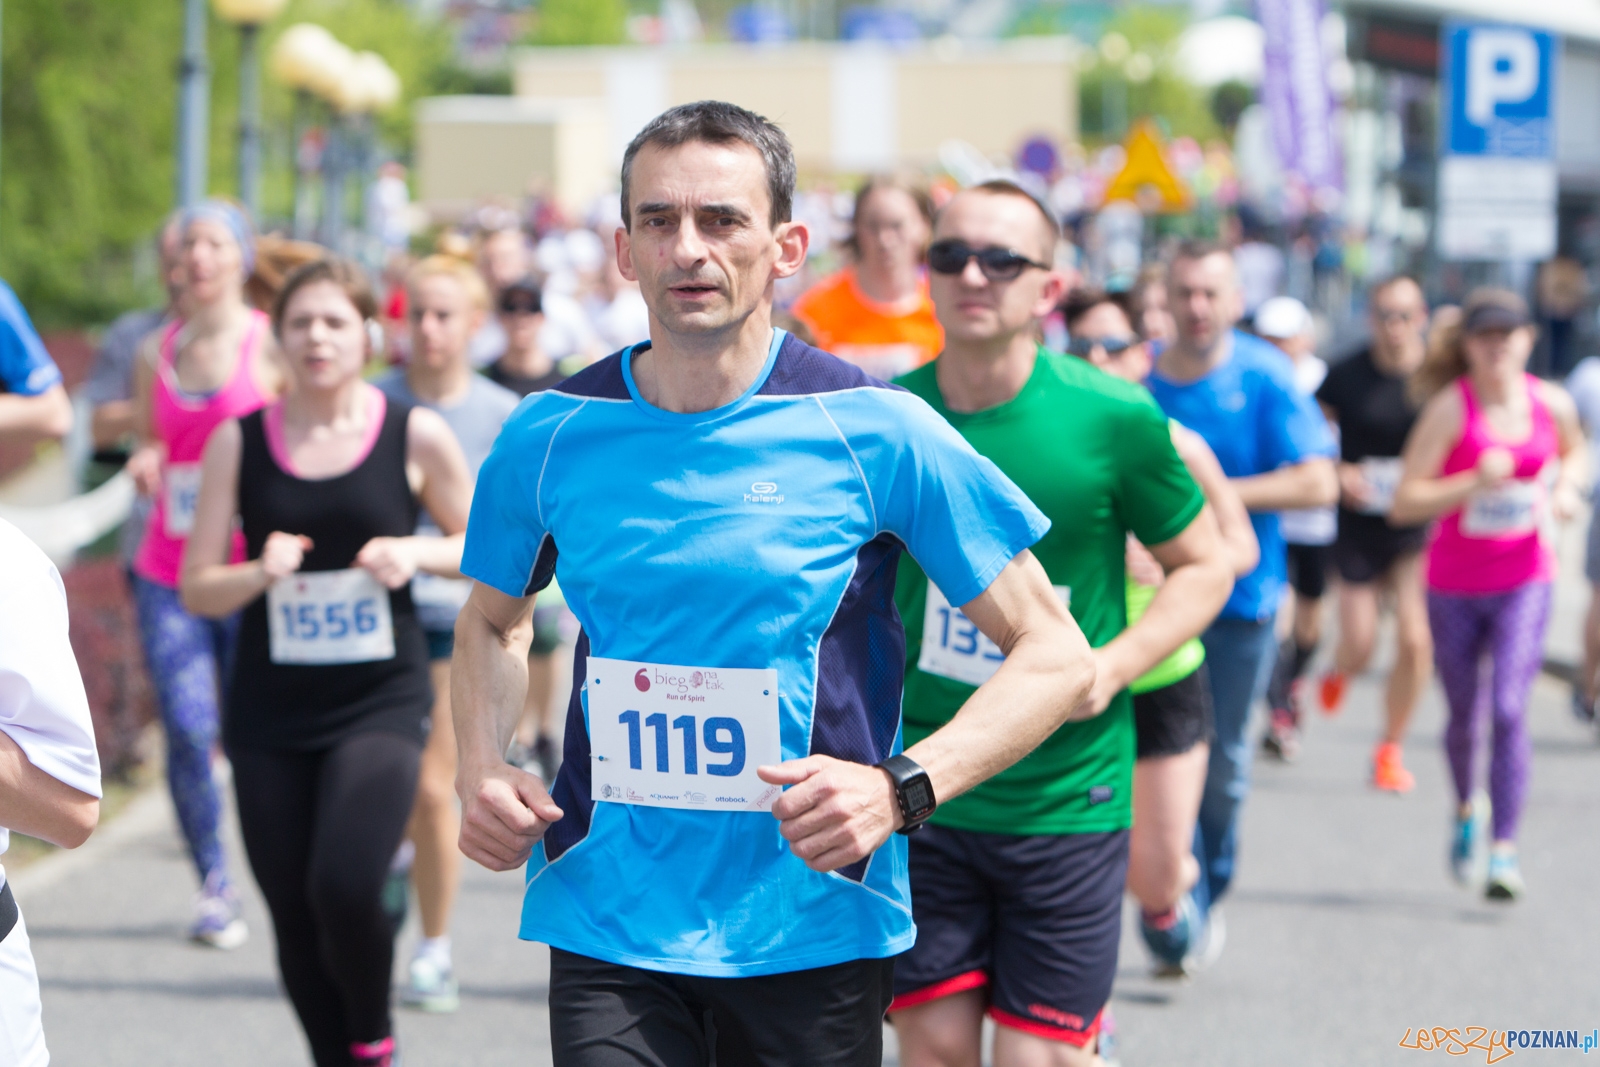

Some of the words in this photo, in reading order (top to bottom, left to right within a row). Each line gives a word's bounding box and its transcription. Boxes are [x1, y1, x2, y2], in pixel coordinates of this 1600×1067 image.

[1466, 26, 1541, 126] P
[281, 598, 378, 641] 1556
[634, 667, 651, 693] 6
[655, 667, 689, 693] bieg
[704, 671, 718, 679] na
[705, 679, 725, 691] tak
[666, 693, 679, 701] Run
[680, 693, 687, 701] of
[688, 694, 706, 703] Spirit
[618, 709, 746, 777] 1119
